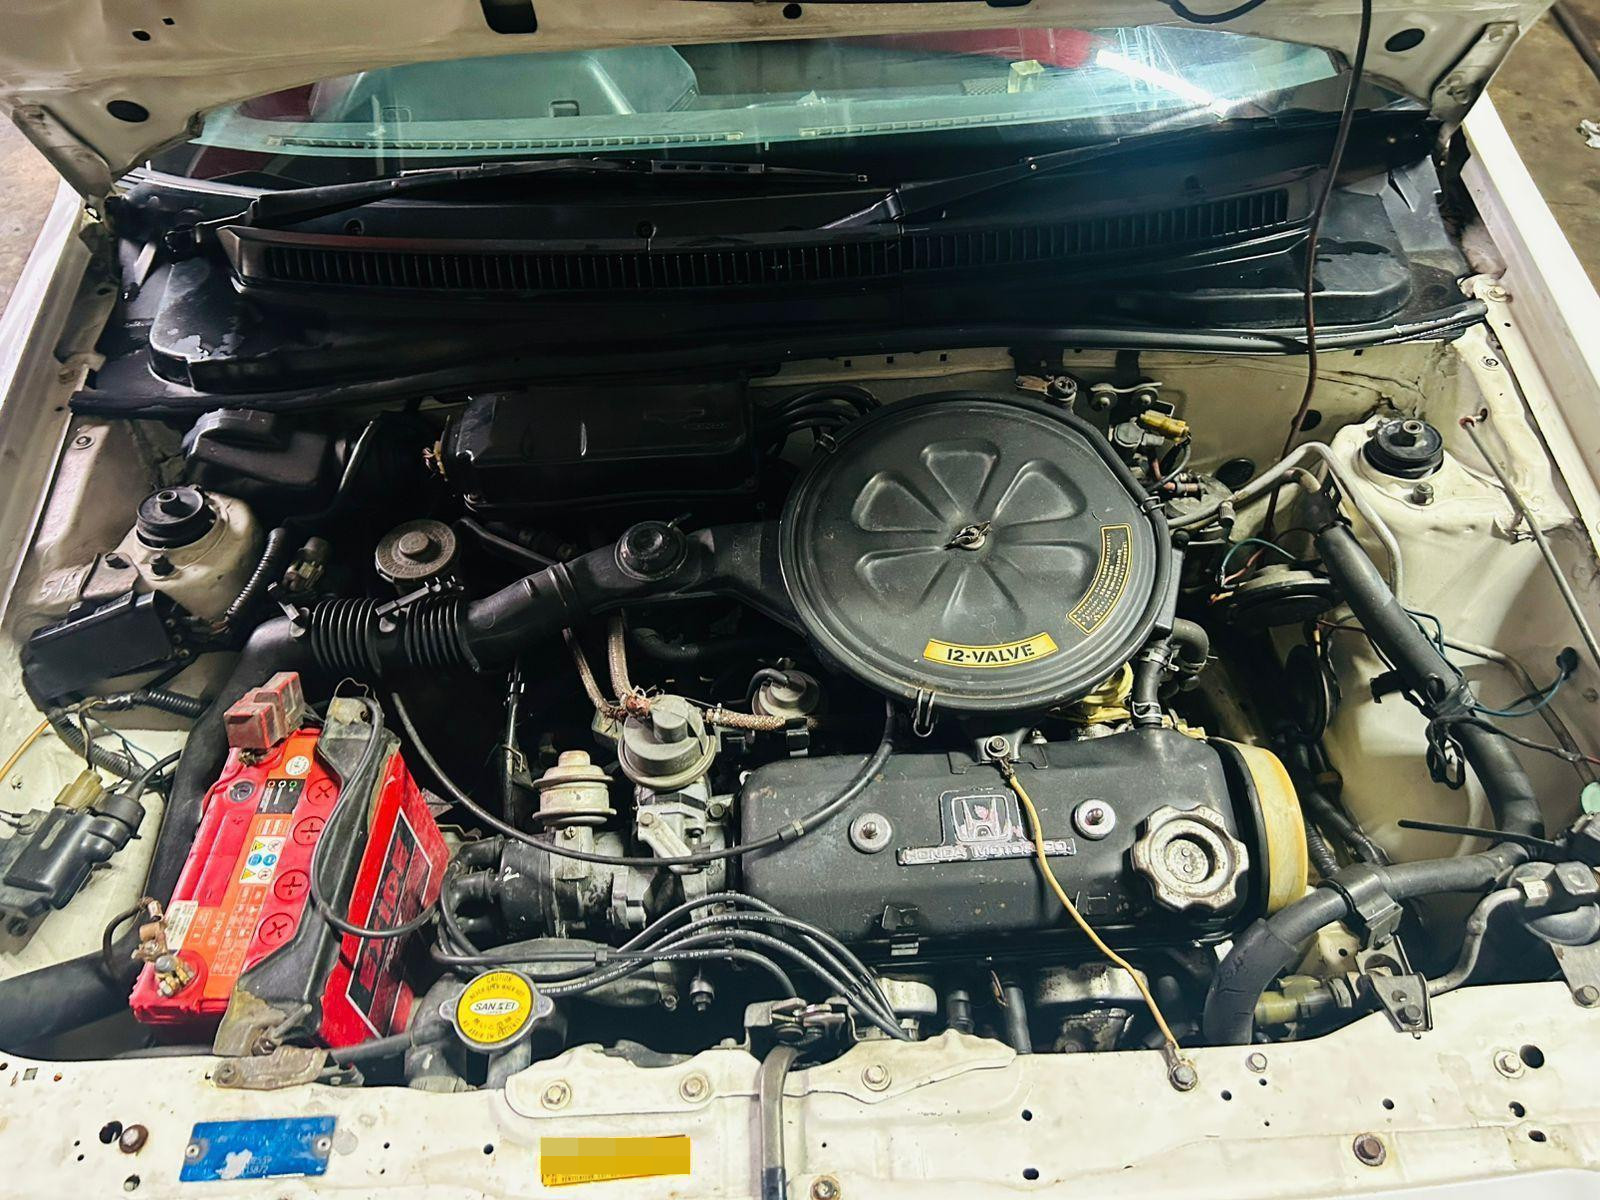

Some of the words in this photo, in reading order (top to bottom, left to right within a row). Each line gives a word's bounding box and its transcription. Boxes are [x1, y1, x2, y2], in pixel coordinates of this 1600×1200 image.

[947, 644, 1035, 662] 12-VALVE
[903, 847, 968, 866] HONDA
[503, 865, 520, 881] 2
[653, 953, 677, 961] JAPAN
[689, 950, 709, 958] MADE
[563, 982, 587, 991] POWER
